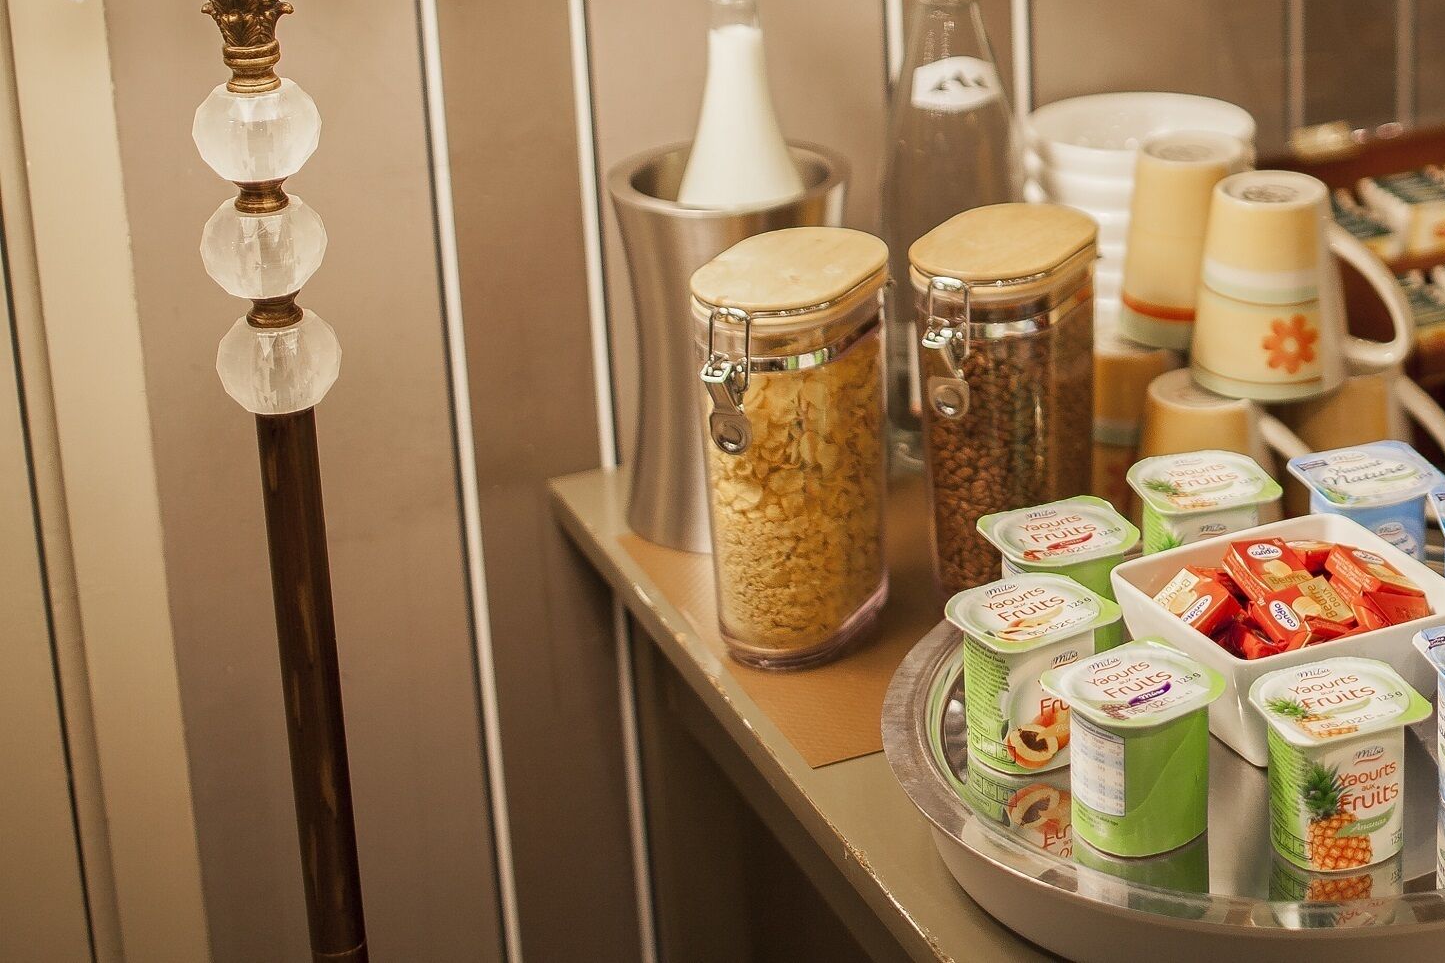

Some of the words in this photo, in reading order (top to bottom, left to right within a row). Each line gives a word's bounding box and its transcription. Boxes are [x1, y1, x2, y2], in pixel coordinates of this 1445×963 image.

[1173, 472, 1240, 490] Fruits
[1322, 463, 1408, 486] Nature
[1018, 514, 1083, 532] Yaourts
[1030, 523, 1097, 544] Fruits
[1268, 573, 1310, 585] Beurre
[981, 587, 1046, 612] Yaourts
[985, 583, 1016, 597] Milsa
[1321, 587, 1341, 608] DOUX
[997, 595, 1065, 623] Fruits
[1307, 584, 1338, 618] Beurre
[1274, 602, 1296, 628] candia
[1052, 649, 1079, 666] Milsa
[1089, 656, 1121, 670] Milsa
[1085, 660, 1150, 688] Yaourts
[1297, 667, 1331, 679] Milsa
[1103, 670, 1173, 699] Fruits
[1287, 674, 1359, 695] Yaourts
[1039, 698, 1070, 717] Fru
[1300, 686, 1376, 710] Fruits
[1355, 745, 1385, 759] Milsa
[1338, 761, 1397, 787] Yaourts
[1339, 782, 1399, 812] Fruits
[1360, 783, 1376, 792] aux
[1350, 817, 1388, 833] Ananas
